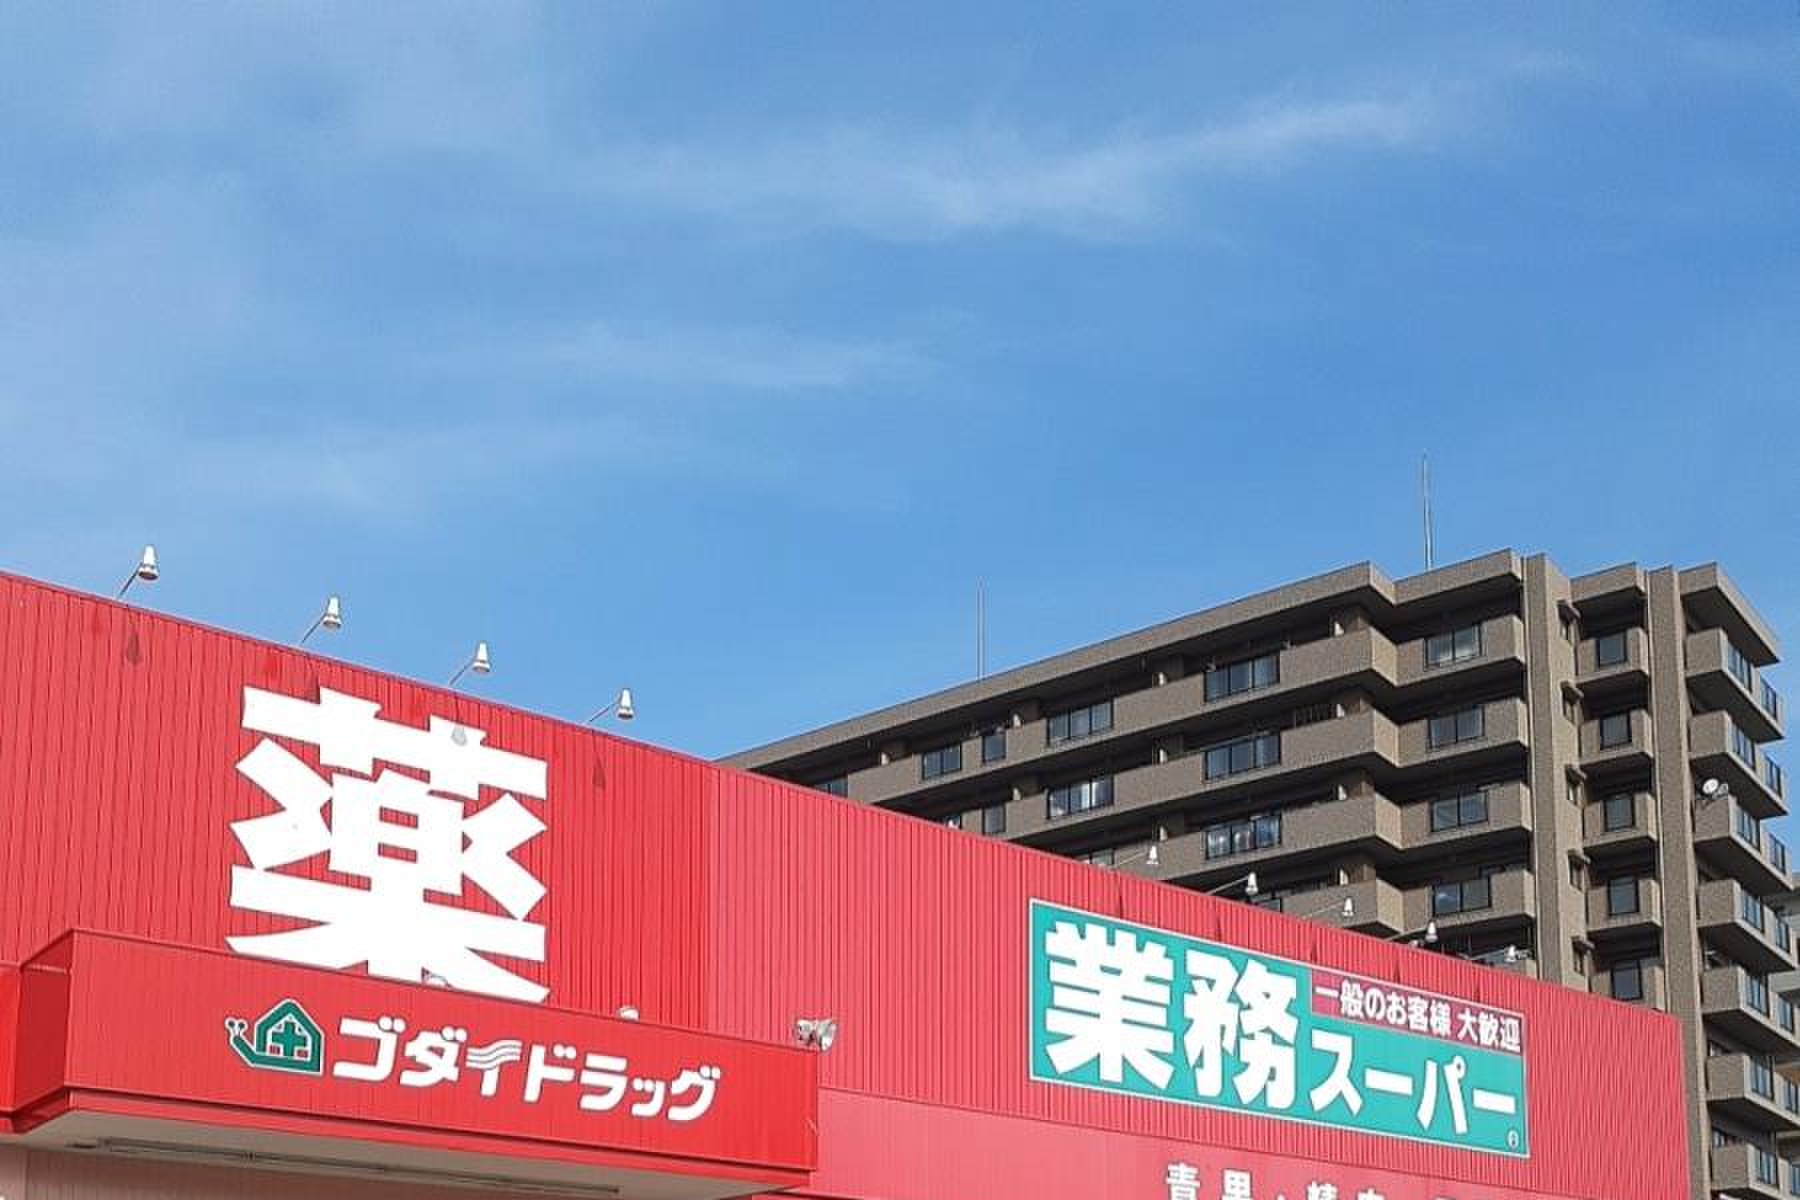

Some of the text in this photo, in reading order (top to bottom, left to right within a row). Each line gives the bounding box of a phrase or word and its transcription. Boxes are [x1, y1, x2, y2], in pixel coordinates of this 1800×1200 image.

[224, 685, 551, 1004] 薬
[332, 1016, 722, 1122] ゴダイドラッグ
[1045, 920, 1518, 1135] 業務スーパー
[1315, 979, 1522, 1054] 一般のお客様 大歓迎
